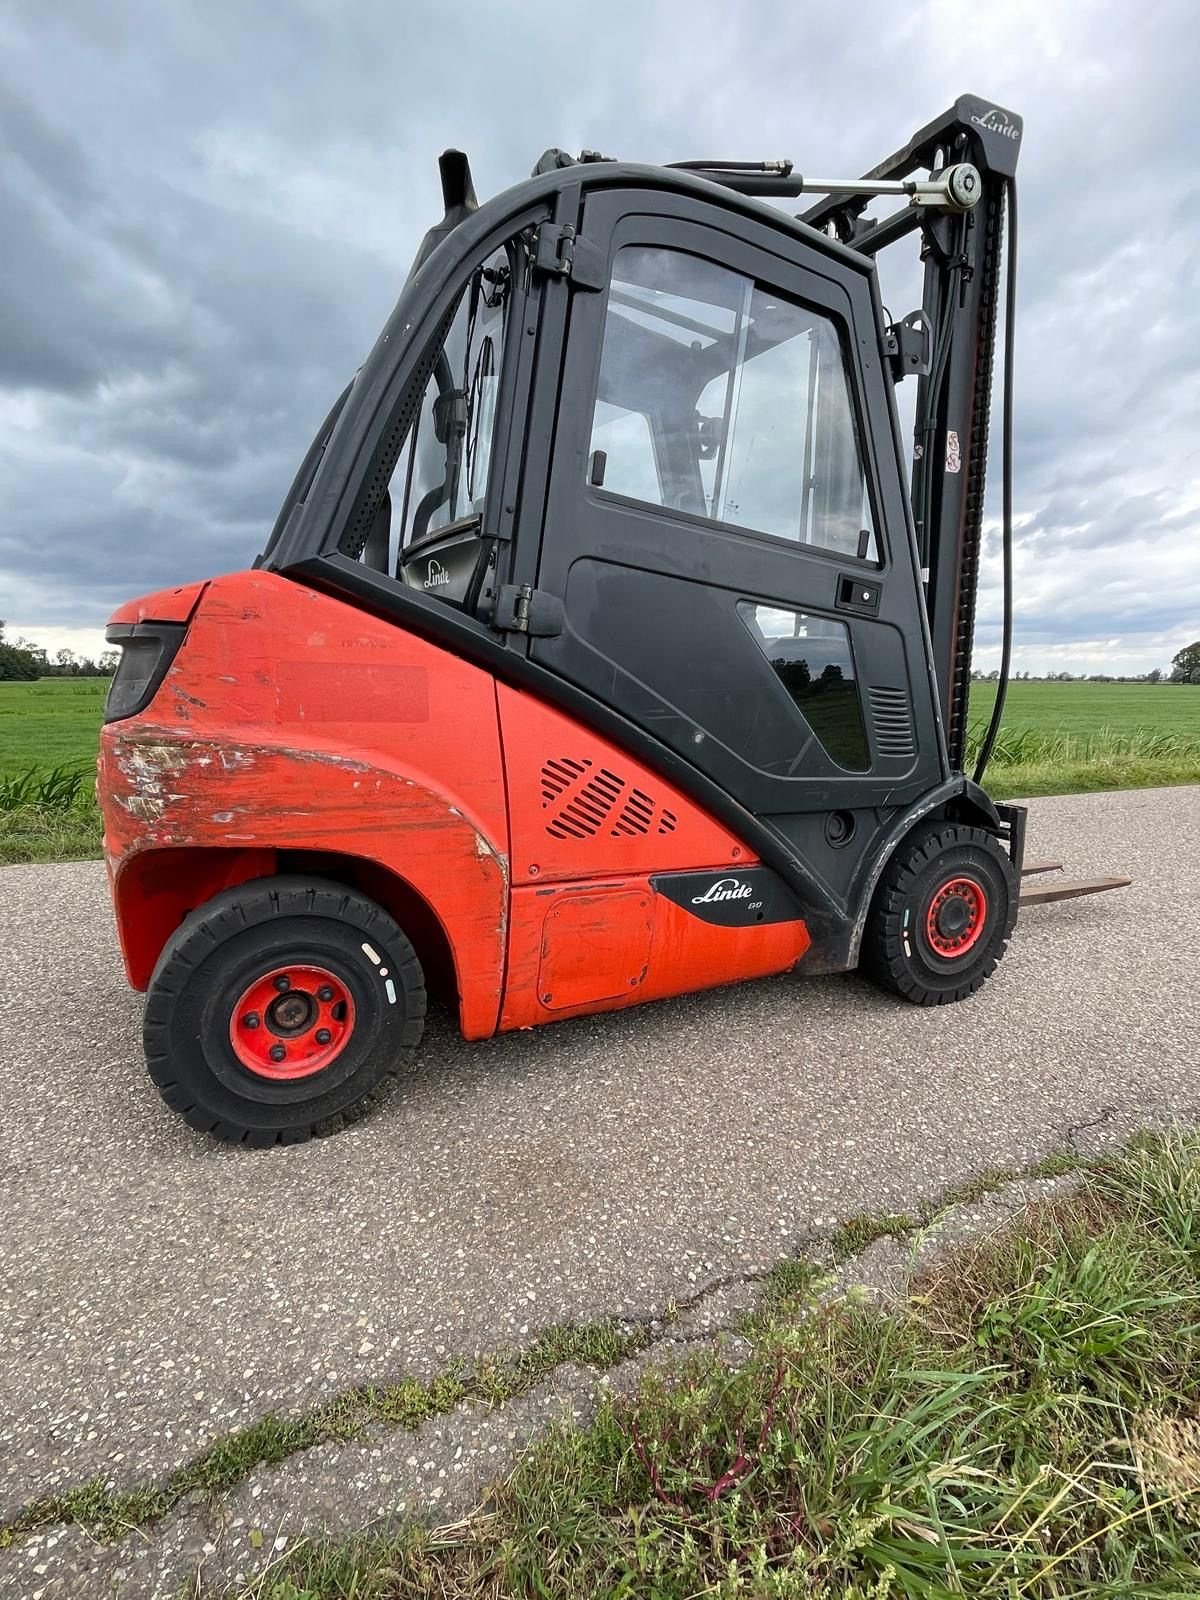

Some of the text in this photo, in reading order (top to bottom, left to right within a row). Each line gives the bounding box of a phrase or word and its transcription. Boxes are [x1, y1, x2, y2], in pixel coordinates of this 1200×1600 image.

[971, 109, 1019, 140] Linde
[424, 559, 450, 588] Linde
[691, 878, 753, 904] Linde
